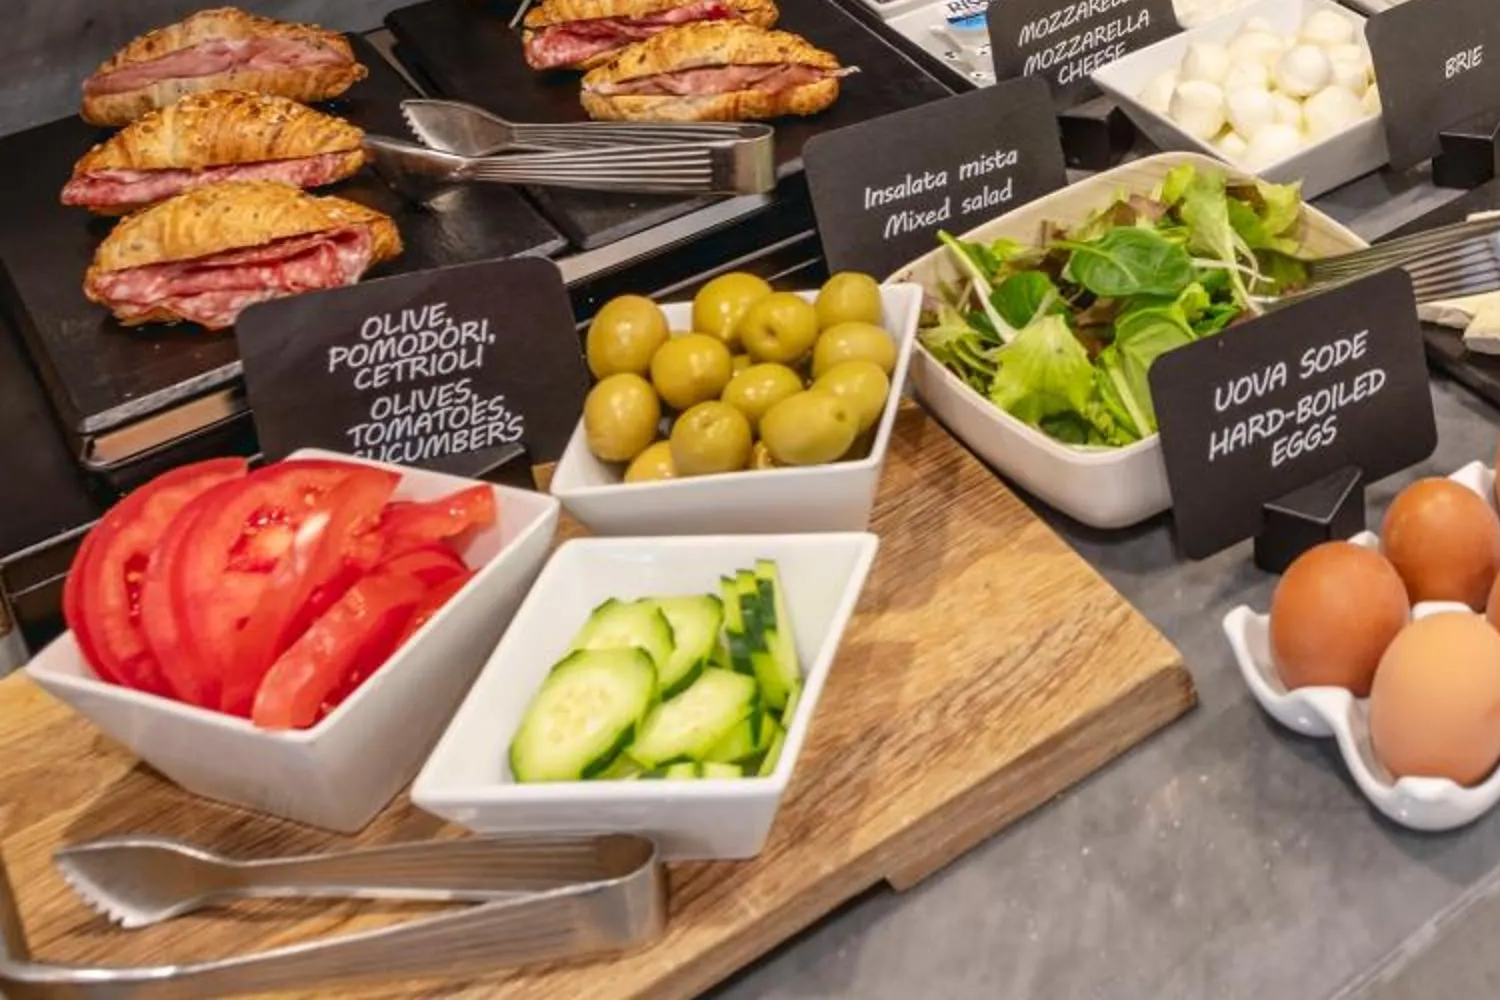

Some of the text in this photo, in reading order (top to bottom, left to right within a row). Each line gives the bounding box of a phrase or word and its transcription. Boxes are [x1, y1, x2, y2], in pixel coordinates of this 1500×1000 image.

[1023, 8, 1149, 78] MOZZARELLA
[1057, 41, 1126, 85] CHEESE
[1444, 45, 1484, 80] BRIE
[864, 149, 1018, 210] Insalata mista
[883, 178, 1014, 240] Mixed salad
[328, 318, 496, 373] POMODORI,
[361, 302, 453, 341] OLIVE,
[354, 344, 484, 390] CETRIOLI
[1215, 329, 1369, 413] UOVA SODE
[348, 395, 512, 447] TOMATOES,
[1208, 368, 1386, 462] HARD-BOILED
[1271, 415, 1338, 468] EGGS
